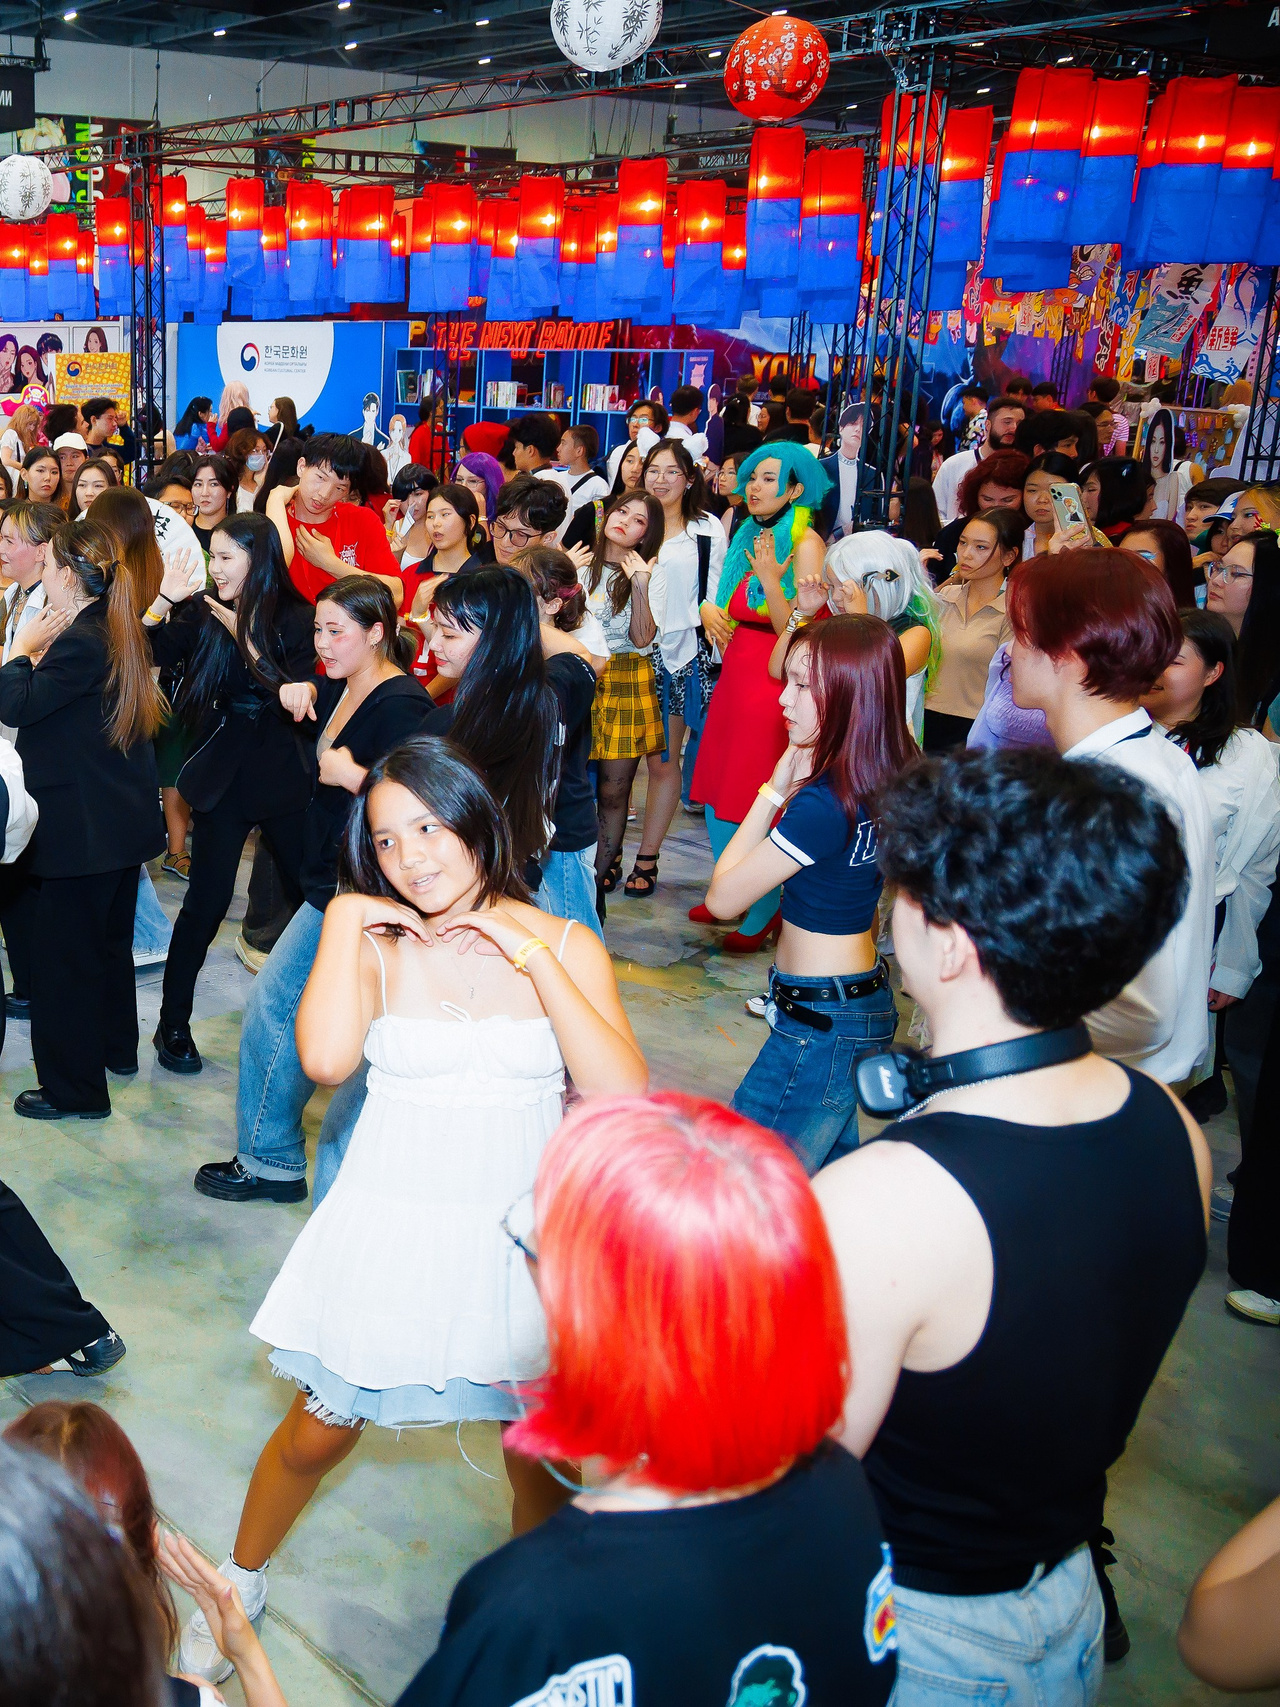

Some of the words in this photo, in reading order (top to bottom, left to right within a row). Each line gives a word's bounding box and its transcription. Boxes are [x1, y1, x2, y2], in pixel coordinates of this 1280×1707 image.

[264, 346, 307, 359] 한국문화원
[479, 322, 536, 359] NEXT
[536, 321, 614, 358] BATTLE
